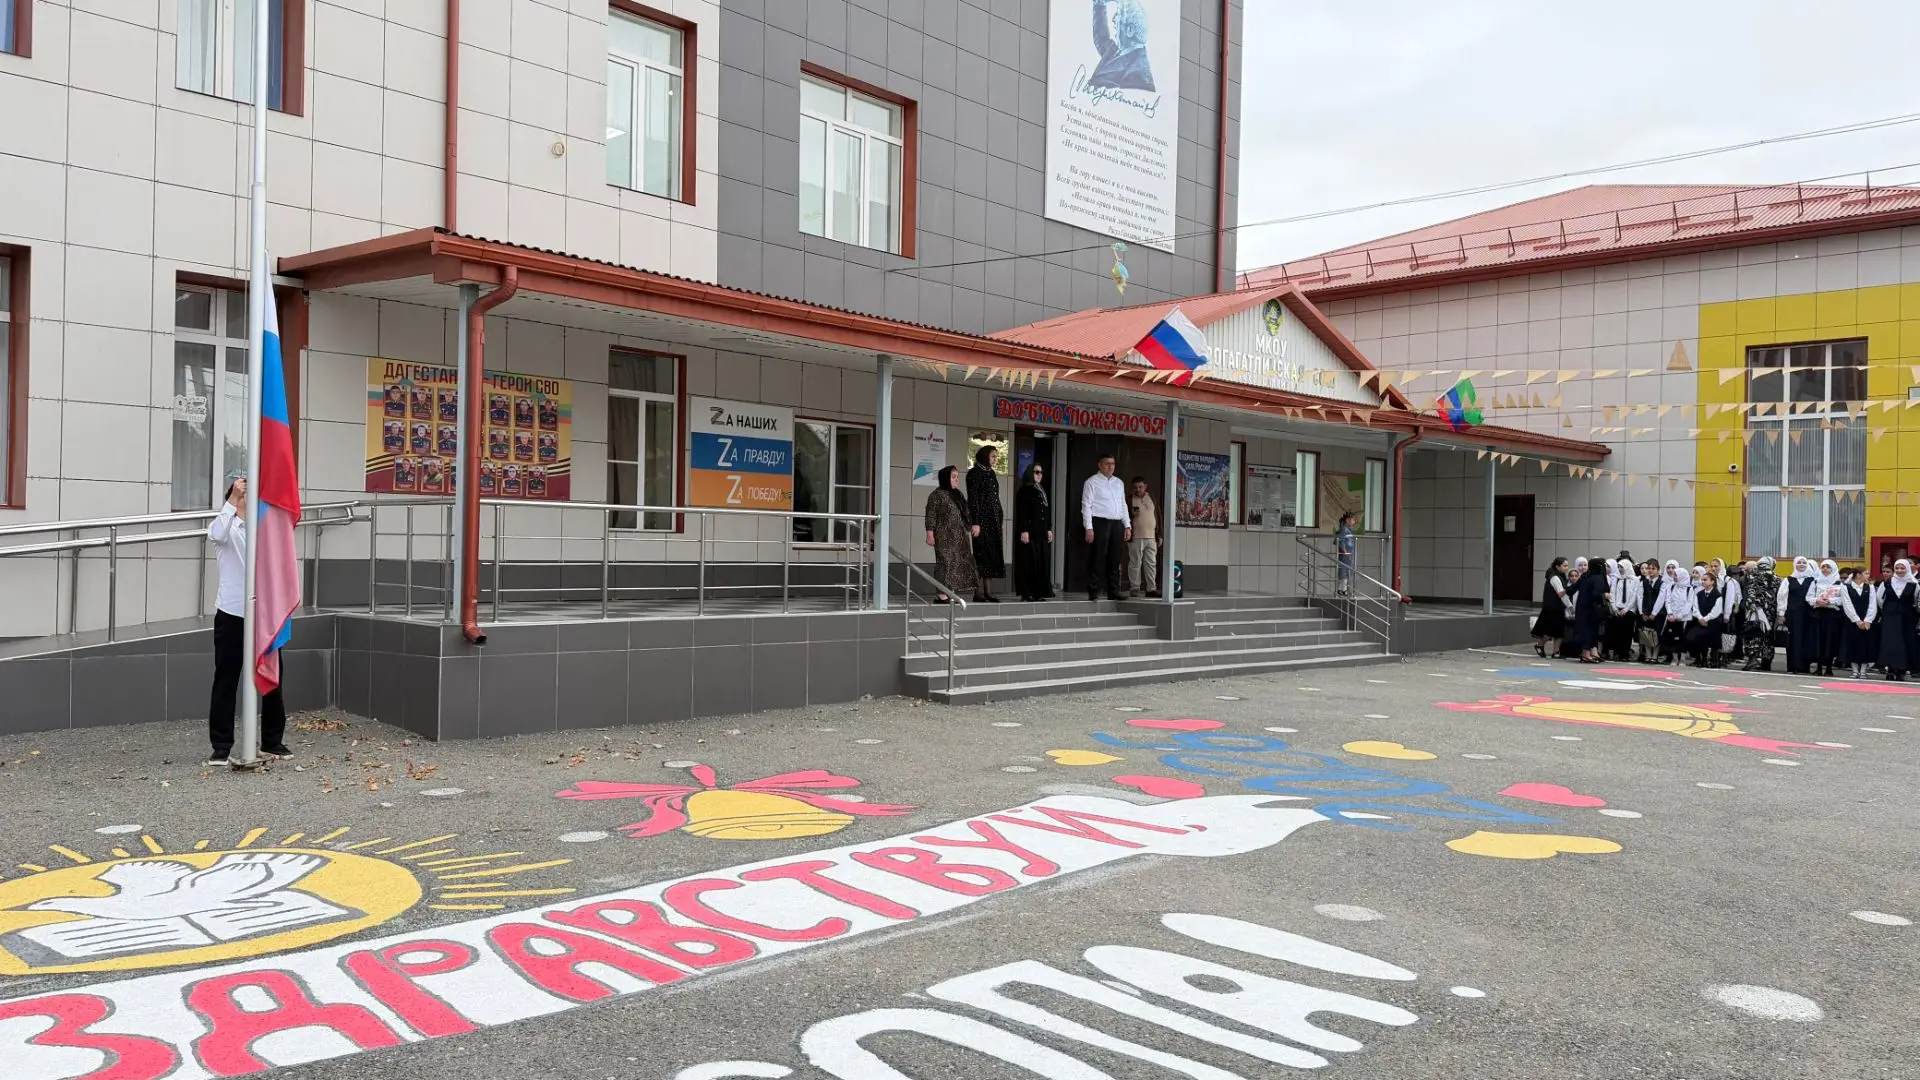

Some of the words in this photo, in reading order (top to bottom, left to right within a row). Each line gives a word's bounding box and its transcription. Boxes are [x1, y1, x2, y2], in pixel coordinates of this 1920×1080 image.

[1255, 334, 1287, 358] МКОУ
[493, 374, 533, 393] ГЕРОИ
[536, 379, 559, 396] СВО
[997, 398, 1064, 424] ДОБРО
[736, 414, 777, 431] НАШИХ
[744, 447, 785, 468] ПРАВДУ!
[747, 486, 782, 503] ПОБЕДУ!
